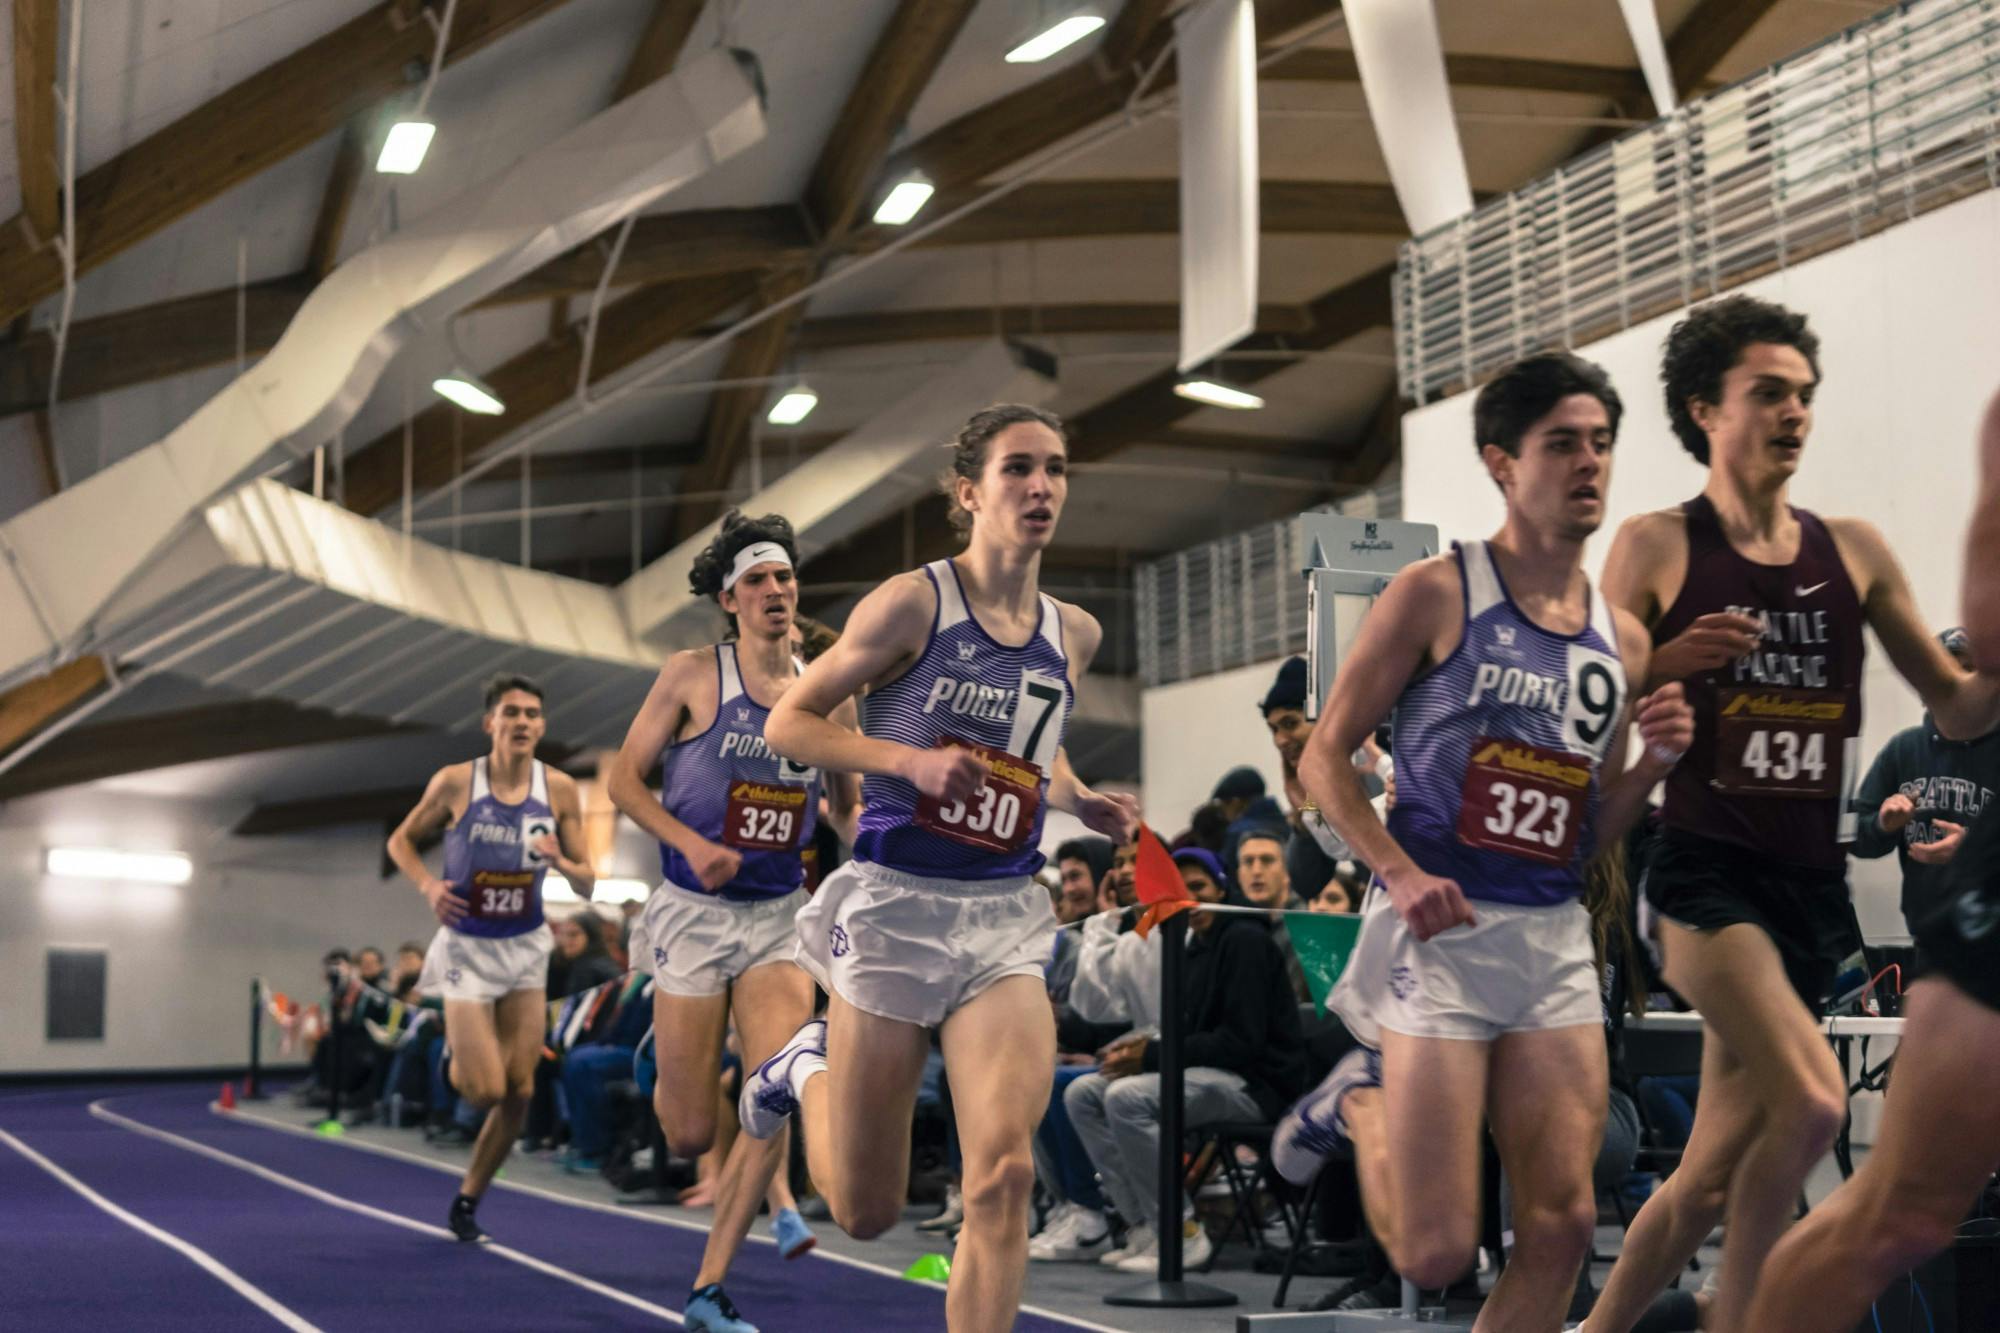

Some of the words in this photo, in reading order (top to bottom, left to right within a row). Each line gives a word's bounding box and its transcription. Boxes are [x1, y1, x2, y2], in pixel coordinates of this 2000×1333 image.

[1725, 605, 1828, 643] ATTLE
[1023, 681, 1062, 761] 7
[1574, 661, 1617, 745] 9
[1741, 730, 1827, 781] 434
[739, 807, 793, 842] 329
[1484, 782, 1570, 848] 323
[481, 887, 524, 913] 326
